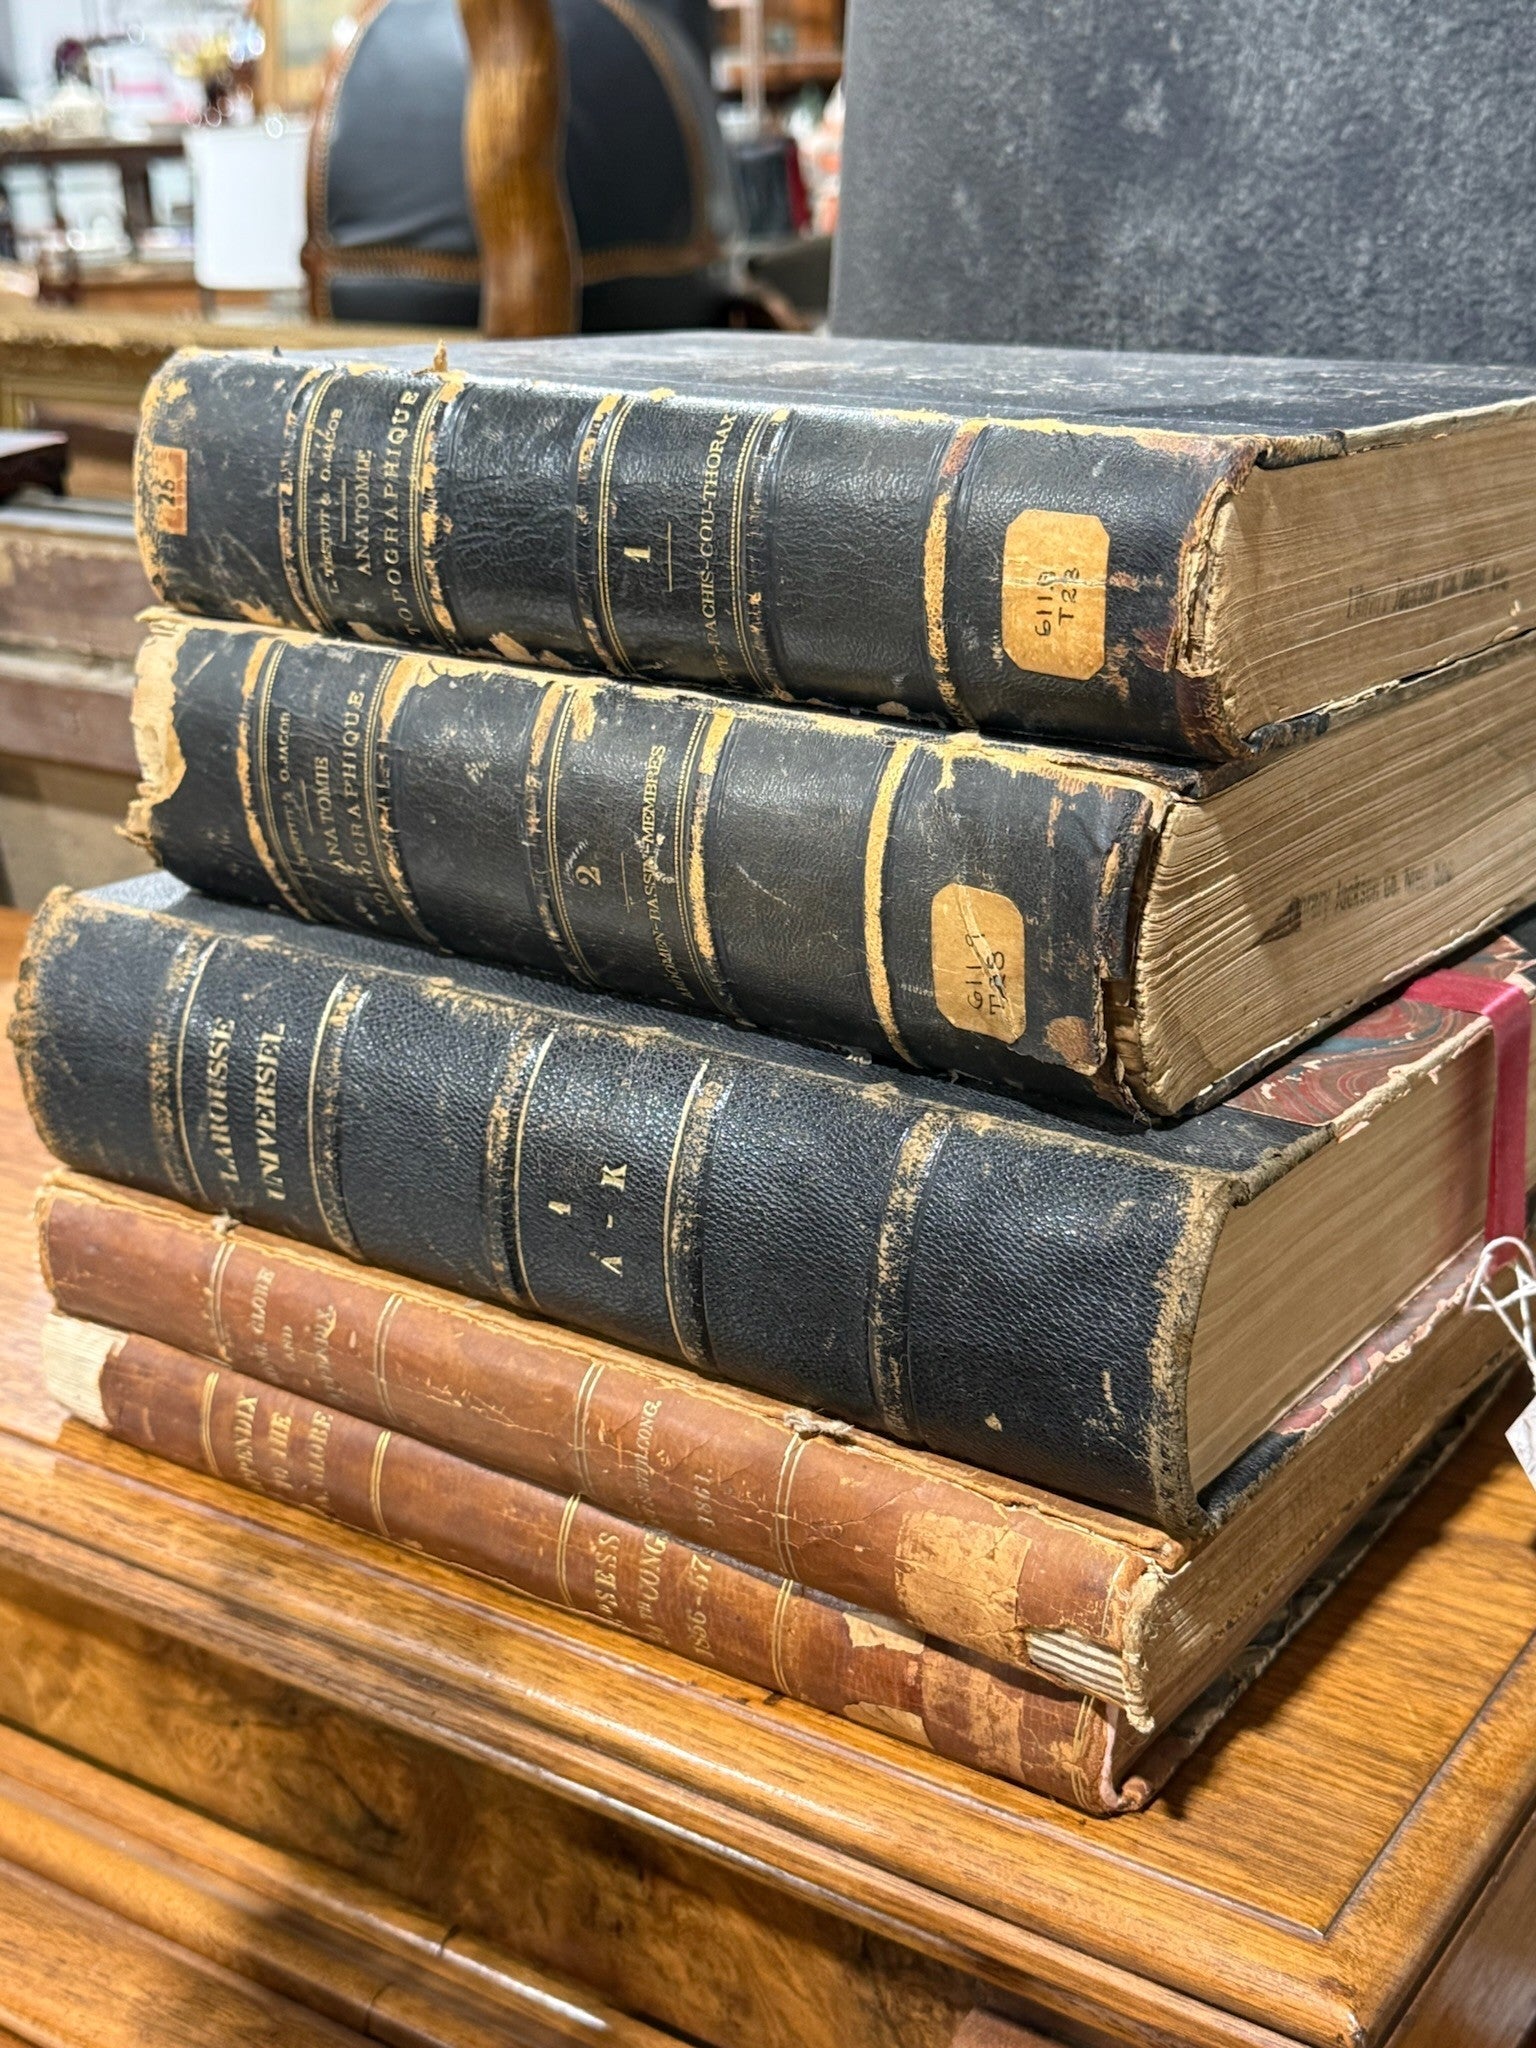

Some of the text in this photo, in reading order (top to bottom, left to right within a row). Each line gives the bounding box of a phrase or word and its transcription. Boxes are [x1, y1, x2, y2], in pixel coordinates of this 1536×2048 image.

[319, 509, 337, 578] TESTUT
[353, 448, 372, 578] ANATOMIE
[382, 390, 420, 637] TOPOGRAPHIQUE
[624, 546, 650, 564] 1
[314, 755, 351, 875] ANATOMIE
[341, 690, 396, 917] TOPOGRAPHIQUE
[574, 864, 602, 887] 2
[206, 1015, 240, 1184] LAROUSSE
[254, 1022, 287, 1202] UNIVERSEL
[547, 1199, 572, 1216] 1
[307, 1409, 334, 1487] GLOBE
[594, 1531, 621, 1609] SESS
